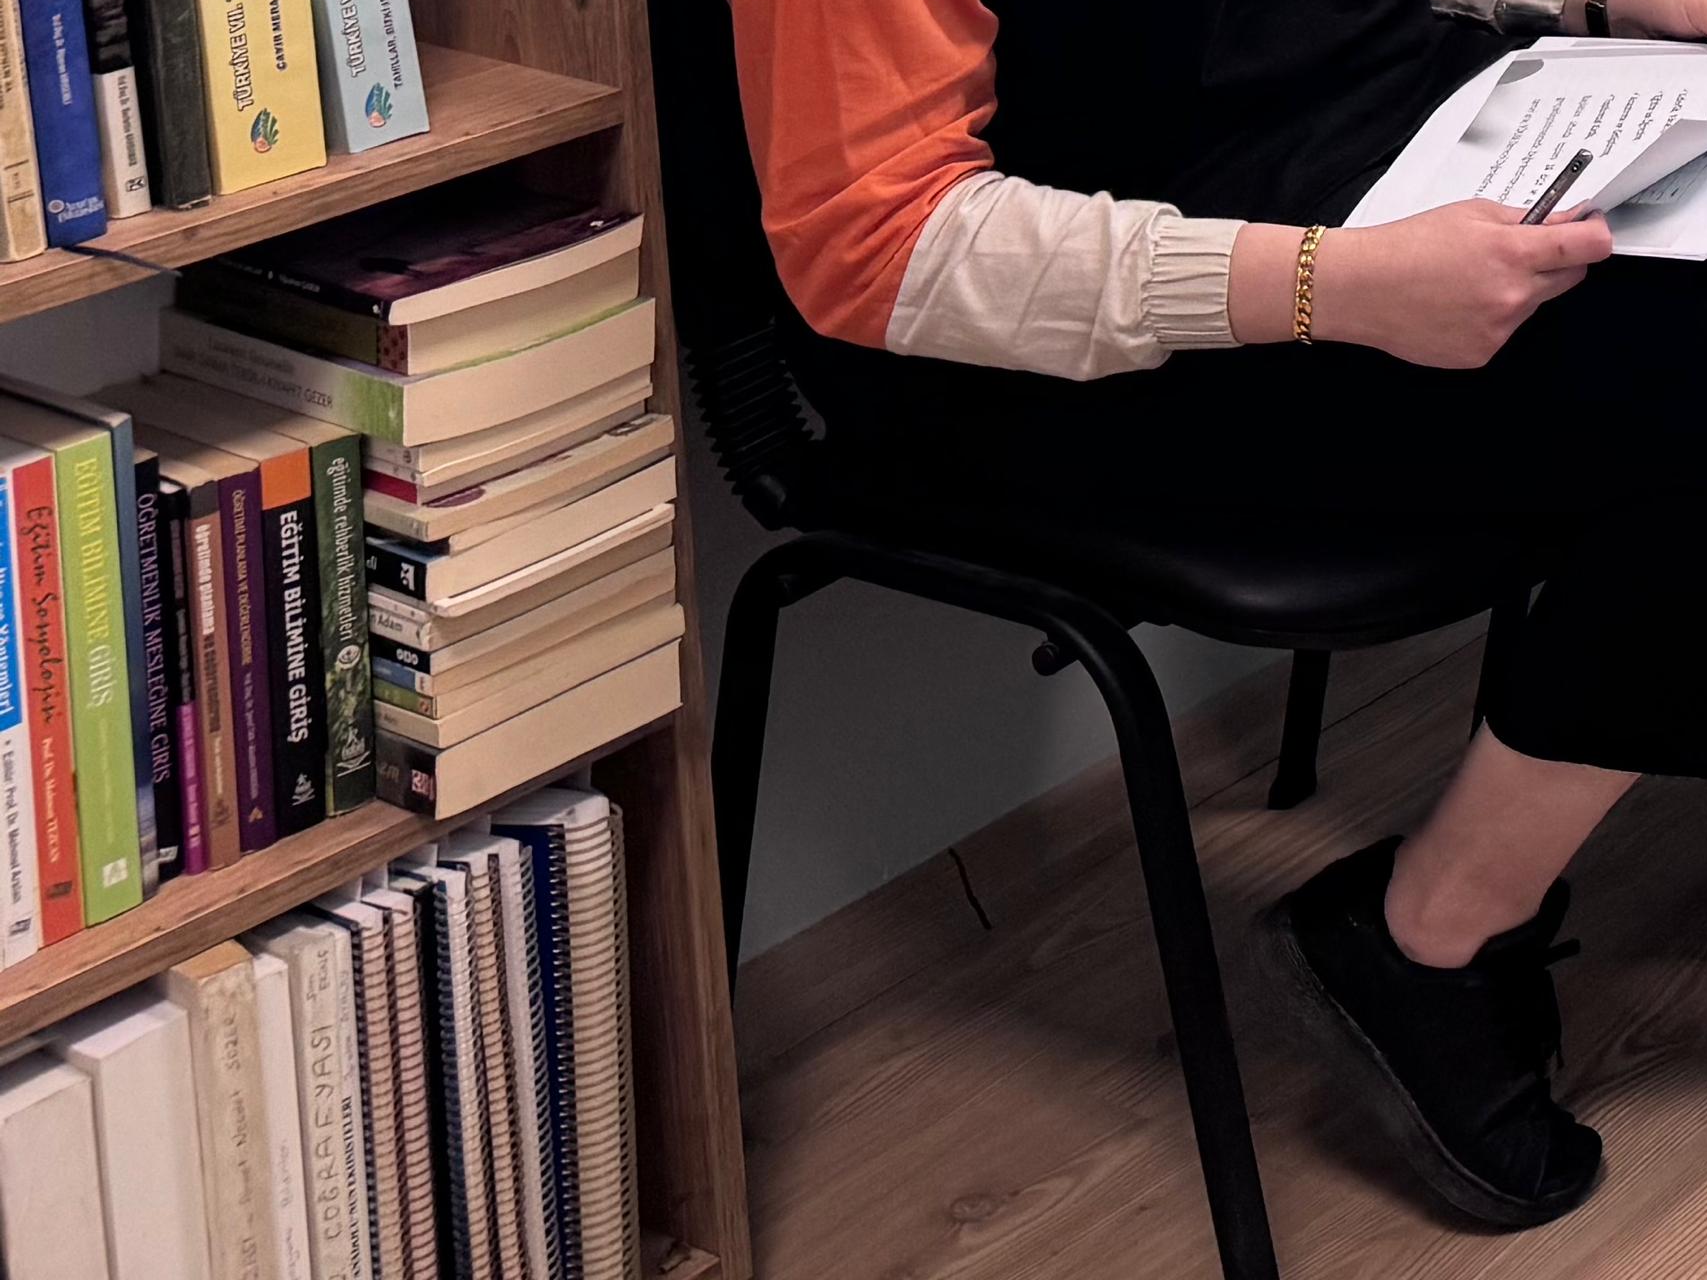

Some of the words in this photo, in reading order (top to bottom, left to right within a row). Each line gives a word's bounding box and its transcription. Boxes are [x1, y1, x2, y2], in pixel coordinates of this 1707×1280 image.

[225, 3, 246, 32] VII.
[340, 5, 367, 78] TÜRKİYE
[228, 33, 255, 112] TÜRKİYE
[74, 457, 102, 536] EĞİTİM
[326, 456, 350, 513] eğitimde
[20, 506, 55, 587] Eğitim
[136, 492, 163, 627] ÖĞRETMENLİK
[279, 510, 303, 585] EĞİTİM
[333, 515, 355, 574] rehberlik
[80, 539, 110, 639] BİLİMİNE
[336, 574, 358, 642] hizmetleri
[27, 594, 64, 725] Sosyolojisi
[284, 588, 309, 682] BİLİMİNE
[85, 642, 119, 707] GİRİŞ
[143, 629, 170, 731] MESLEĞİNE
[286, 683, 312, 743] GİRİŞ
[150, 732, 173, 785] GİRİŞ
[310, 1024, 343, 1240] COĞRAFYASI
